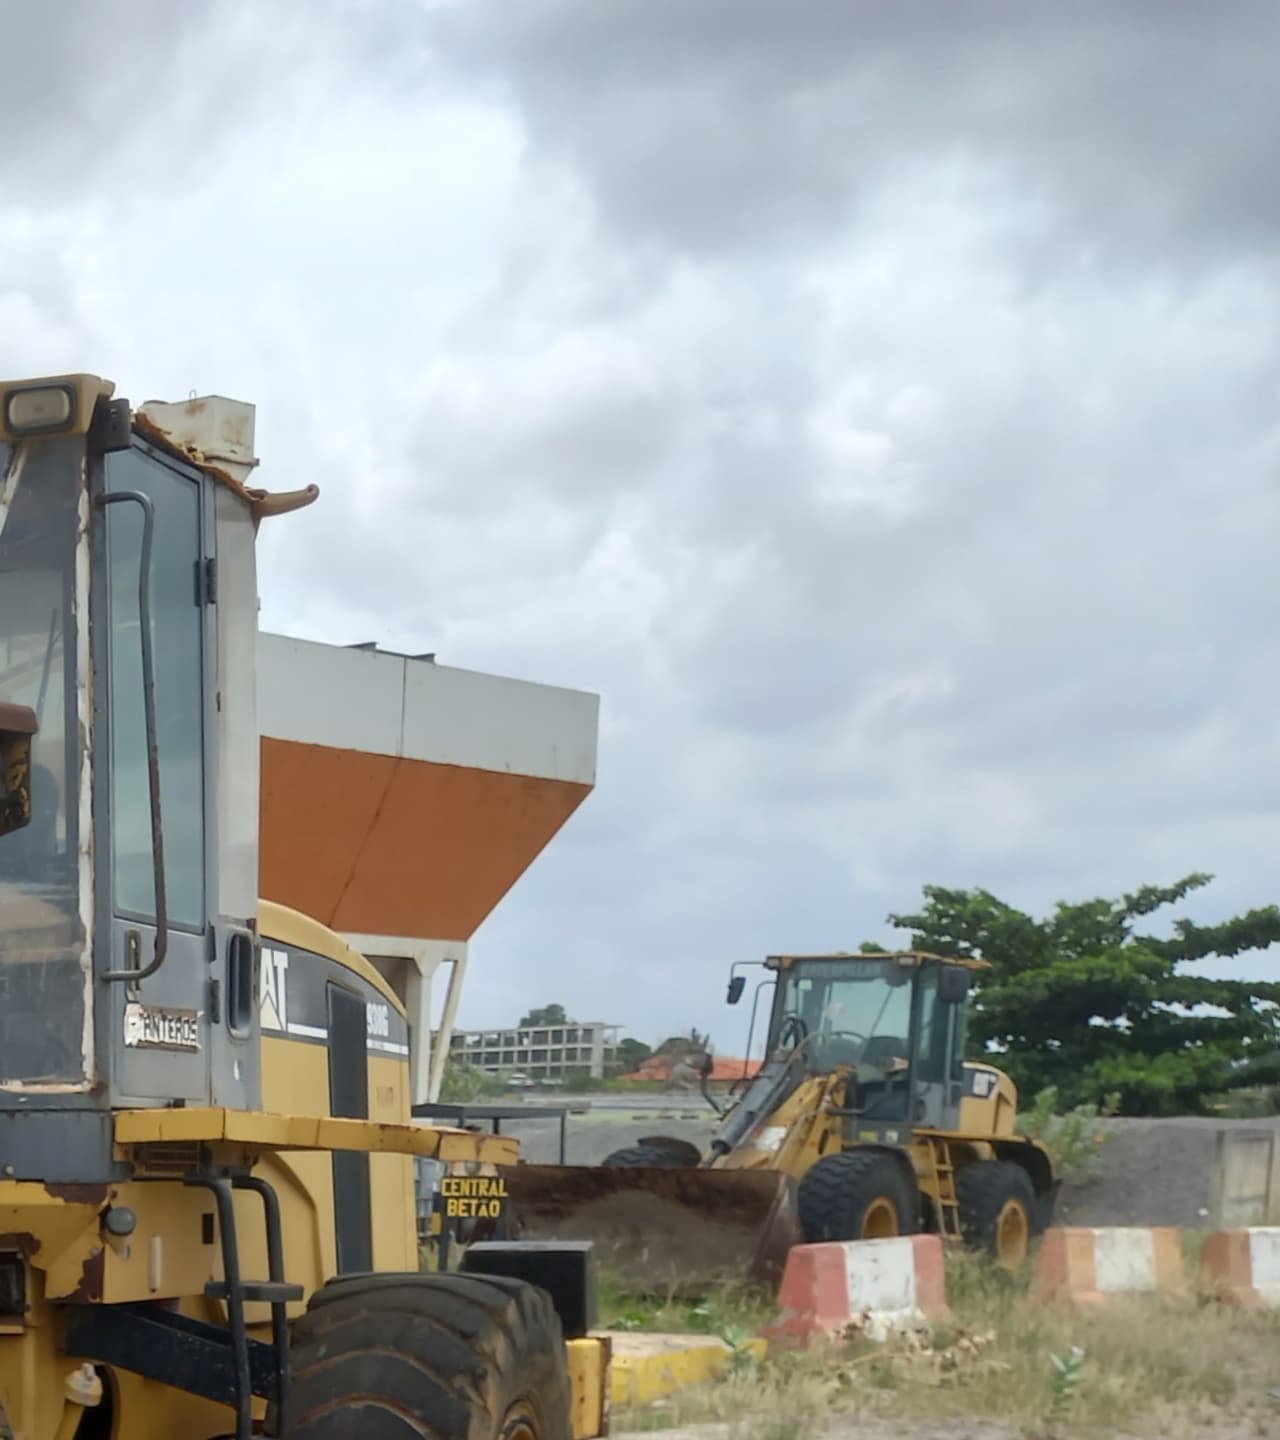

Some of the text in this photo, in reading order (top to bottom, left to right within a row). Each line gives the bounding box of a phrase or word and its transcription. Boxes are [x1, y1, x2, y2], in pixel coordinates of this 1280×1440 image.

[260, 947, 289, 1032] AT
[441, 1178, 509, 1197] CENTRAL
[447, 1198, 500, 1218] BETÃO
